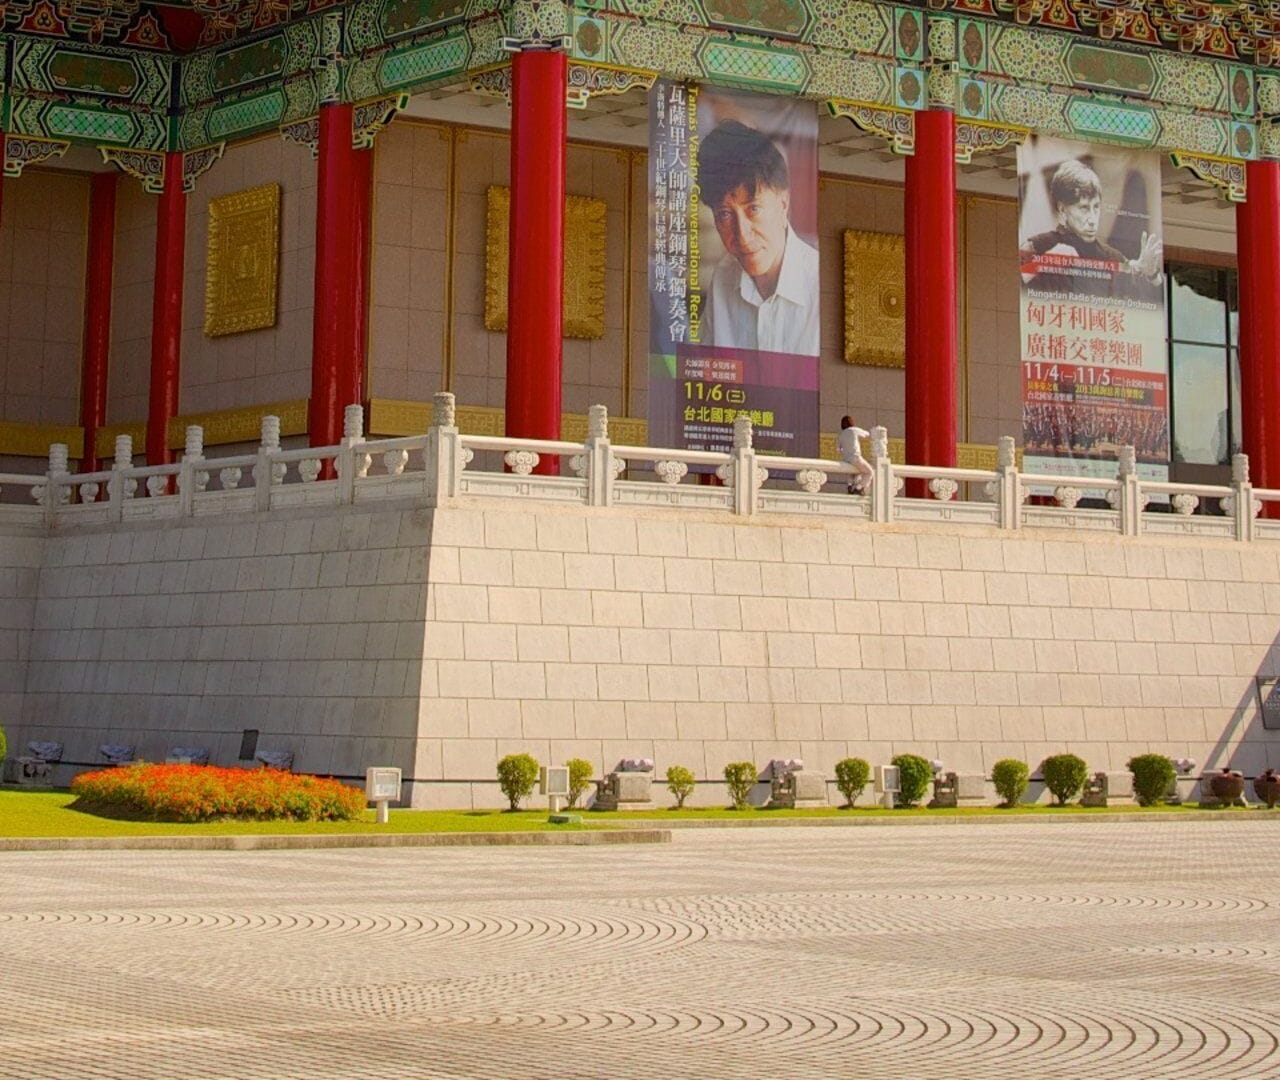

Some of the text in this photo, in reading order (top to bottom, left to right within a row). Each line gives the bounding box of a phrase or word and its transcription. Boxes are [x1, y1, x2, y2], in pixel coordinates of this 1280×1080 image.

[688, 86, 699, 132] Tamás
[668, 84, 687, 343] 瓦薩里大師講座鋼琴獨奏會
[689, 183, 701, 290] Conversational
[1027, 288, 1067, 301] Hungarian
[1069, 292, 1090, 302] Radio
[689, 294, 702, 344] Recital
[1026, 301, 1125, 334] 匈牙利國家
[1026, 332, 1142, 367] 廣播交響樂團
[684, 381, 723, 402] 11/6
